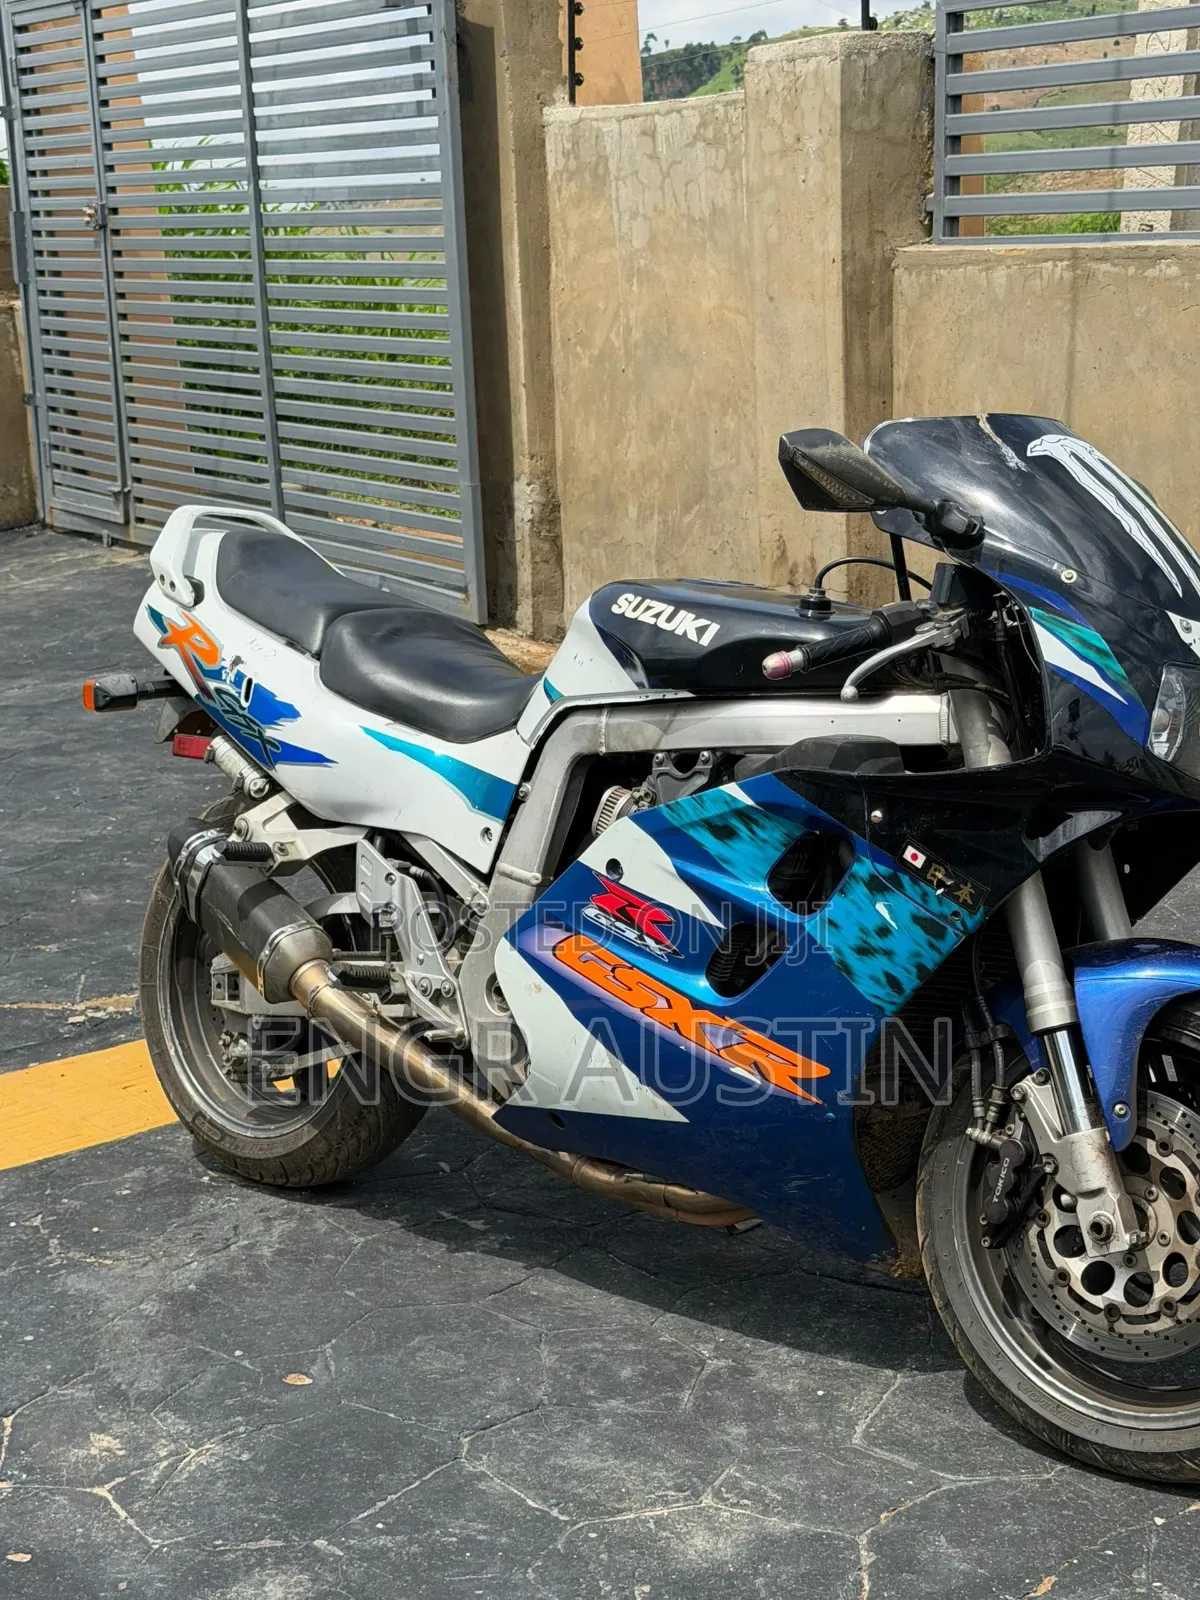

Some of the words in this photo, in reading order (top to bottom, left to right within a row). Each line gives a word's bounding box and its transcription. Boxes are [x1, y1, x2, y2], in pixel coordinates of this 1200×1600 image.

[611, 593, 721, 647] SUZUKI
[582, 905, 670, 962] GSX
[992, 1157, 1010, 1204] TOKICO
